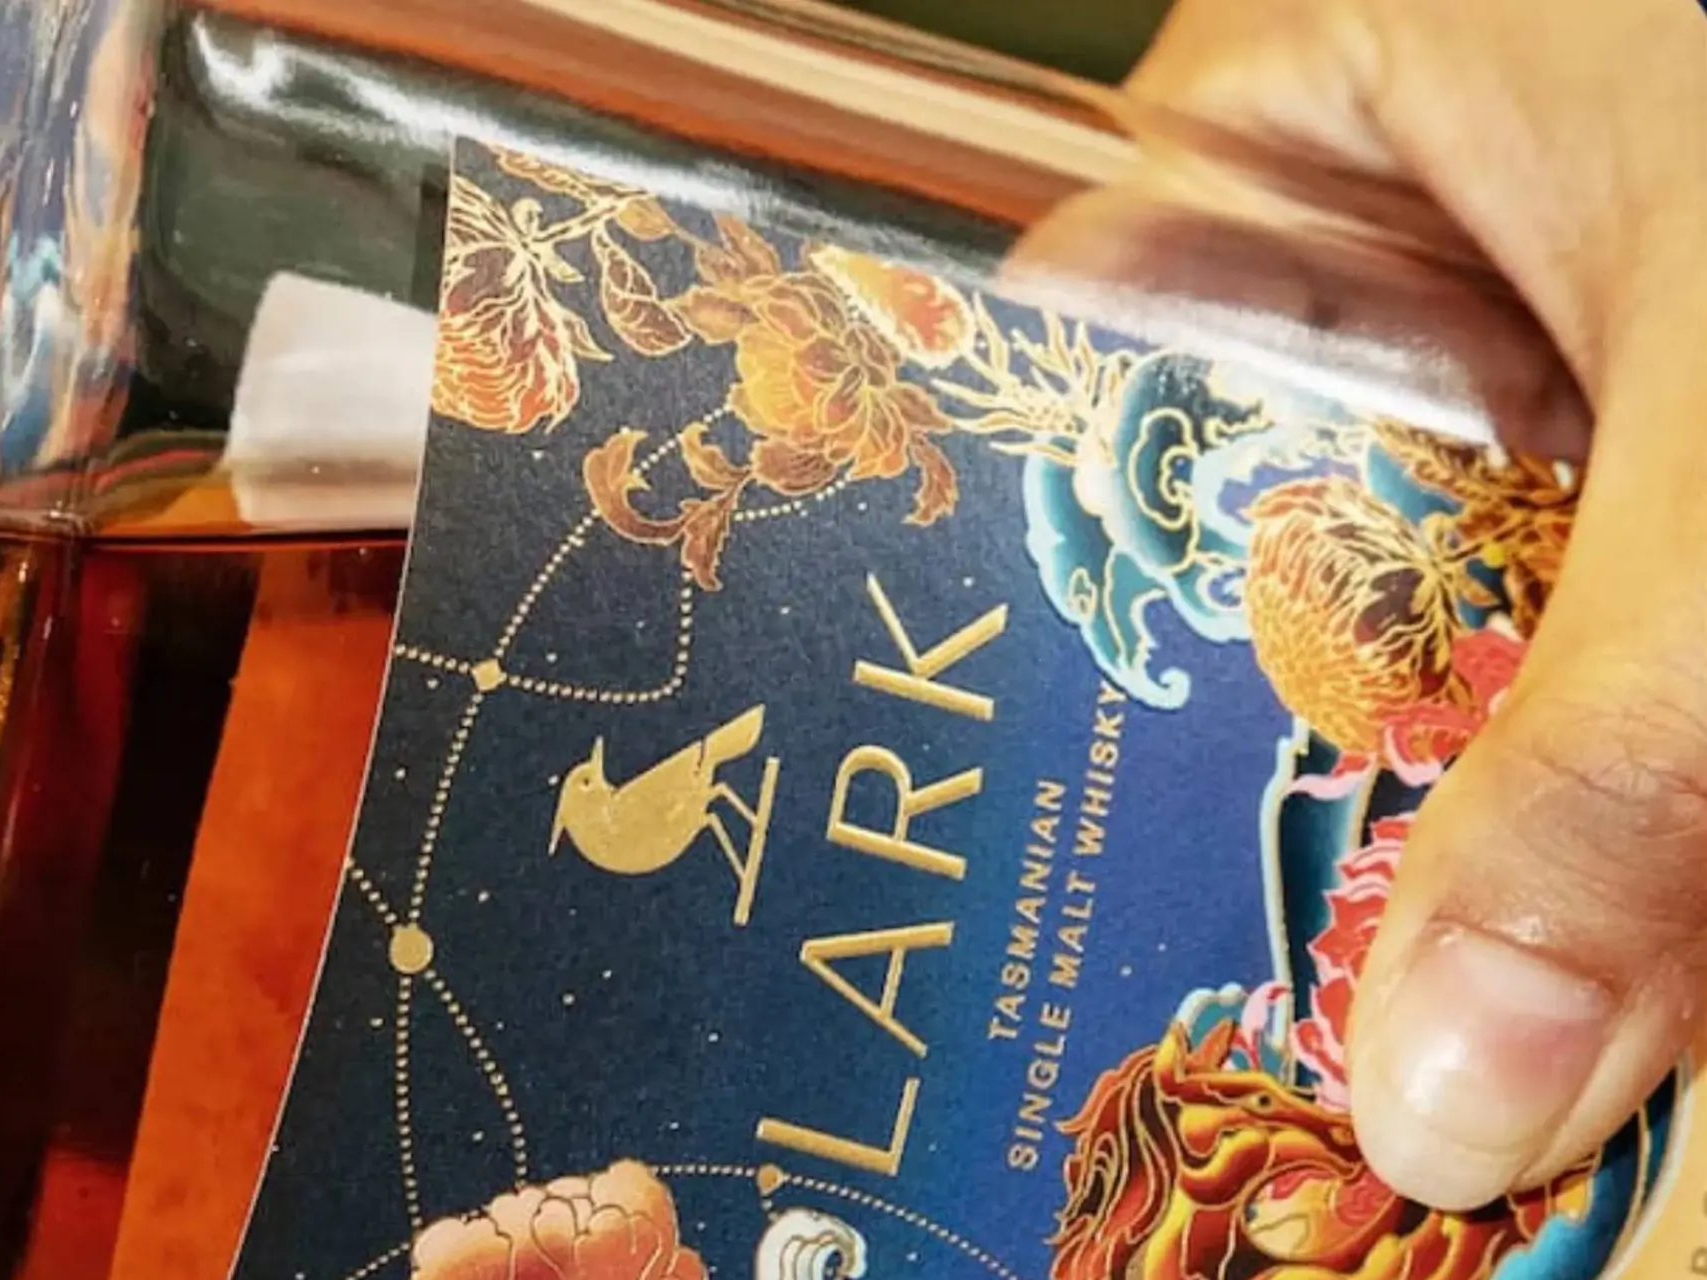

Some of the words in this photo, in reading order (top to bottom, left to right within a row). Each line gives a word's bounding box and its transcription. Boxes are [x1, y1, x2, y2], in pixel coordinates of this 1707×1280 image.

[755, 571, 1008, 1178] LARK
[987, 779, 1066, 1039] TASMANIAN
[1008, 1002, 1072, 1171] SINGLE
[1049, 869, 1095, 988] MALT
[1072, 678, 1127, 855] WHISKY
